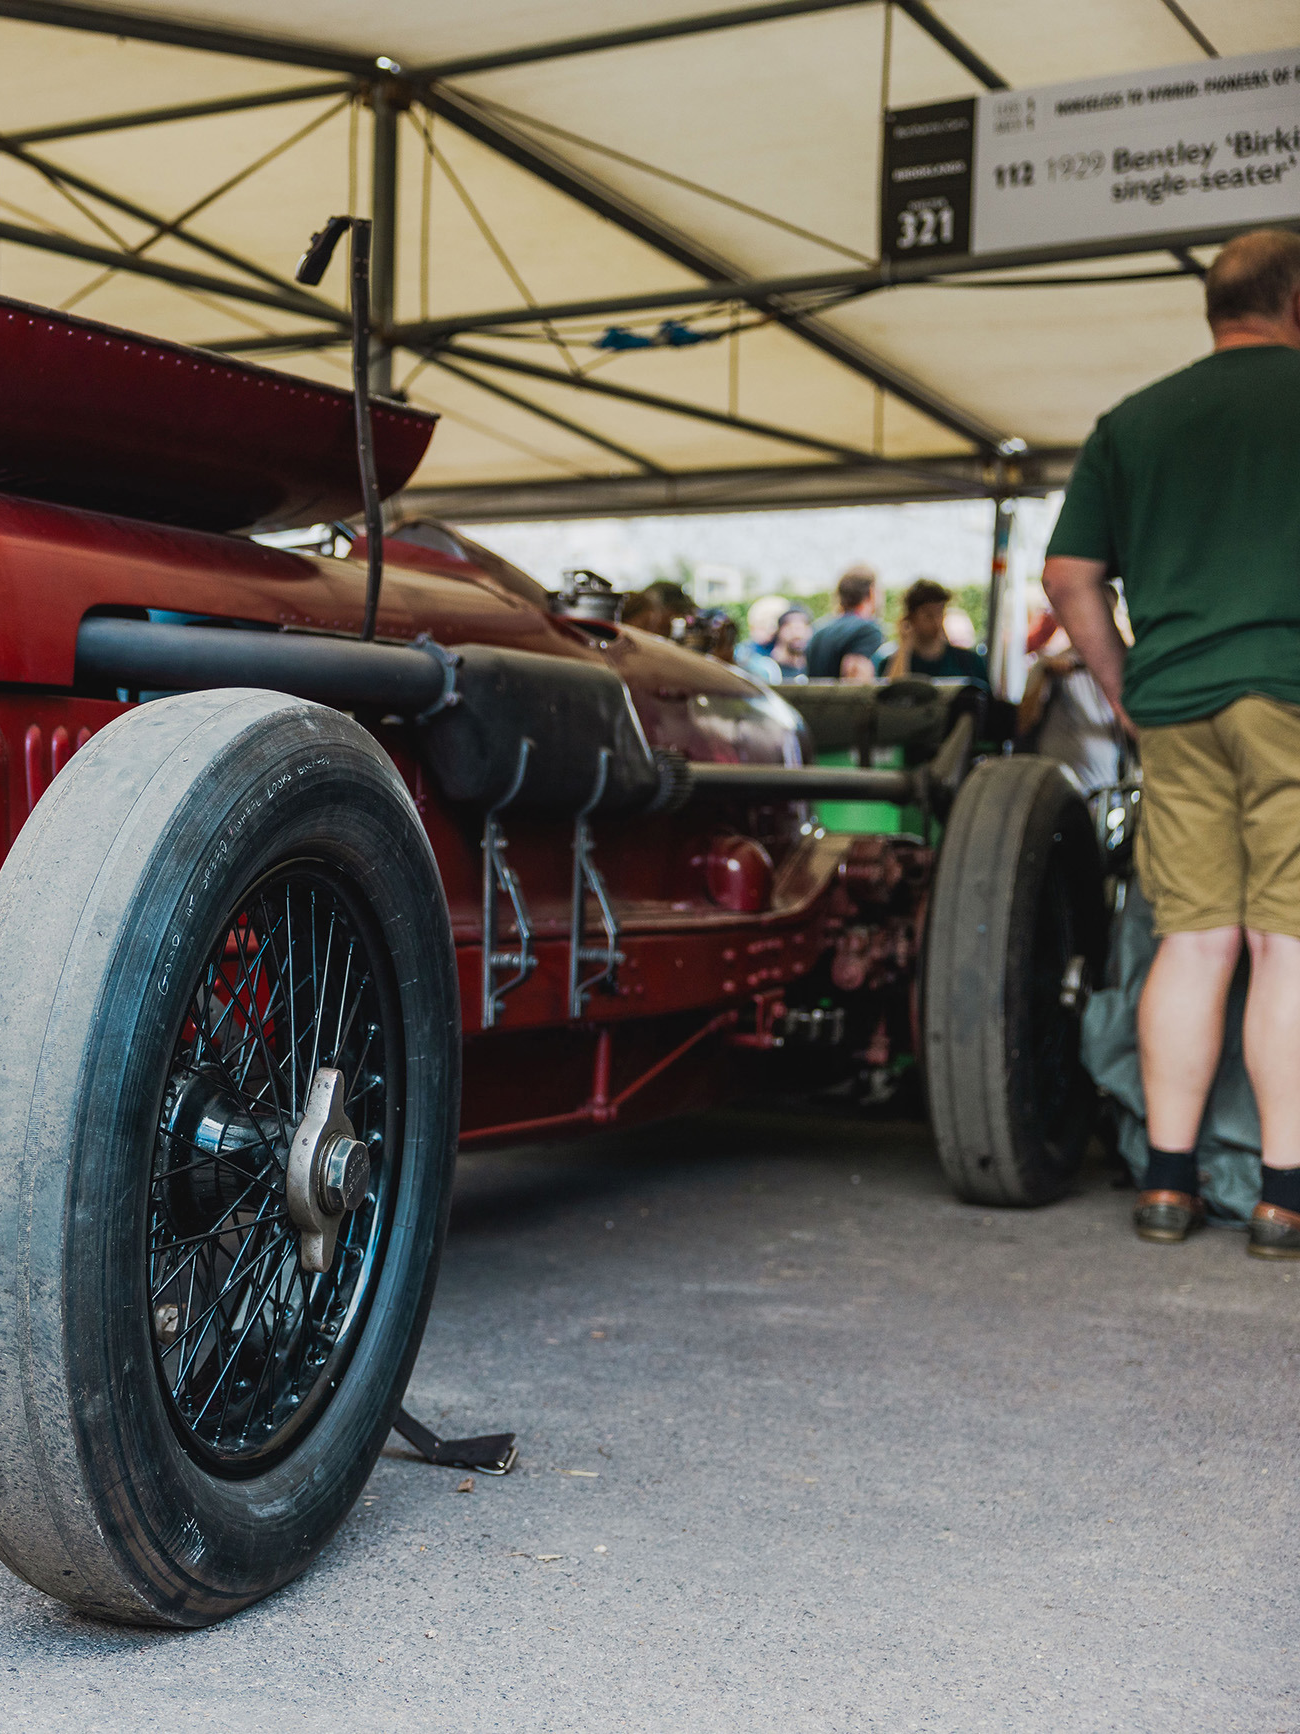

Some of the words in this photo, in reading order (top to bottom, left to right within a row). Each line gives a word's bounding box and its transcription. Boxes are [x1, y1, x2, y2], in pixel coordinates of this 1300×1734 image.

[995, 160, 1035, 189] 112
[1045, 150, 1106, 183] 1929
[1112, 139, 1217, 174] Bentley
[896, 207, 954, 249] 321
[158, 934, 180, 995] GOOD
[185, 894, 195, 917] AT
[202, 840, 228, 889] SPEED
[266, 770, 292, 799] LOOKS
